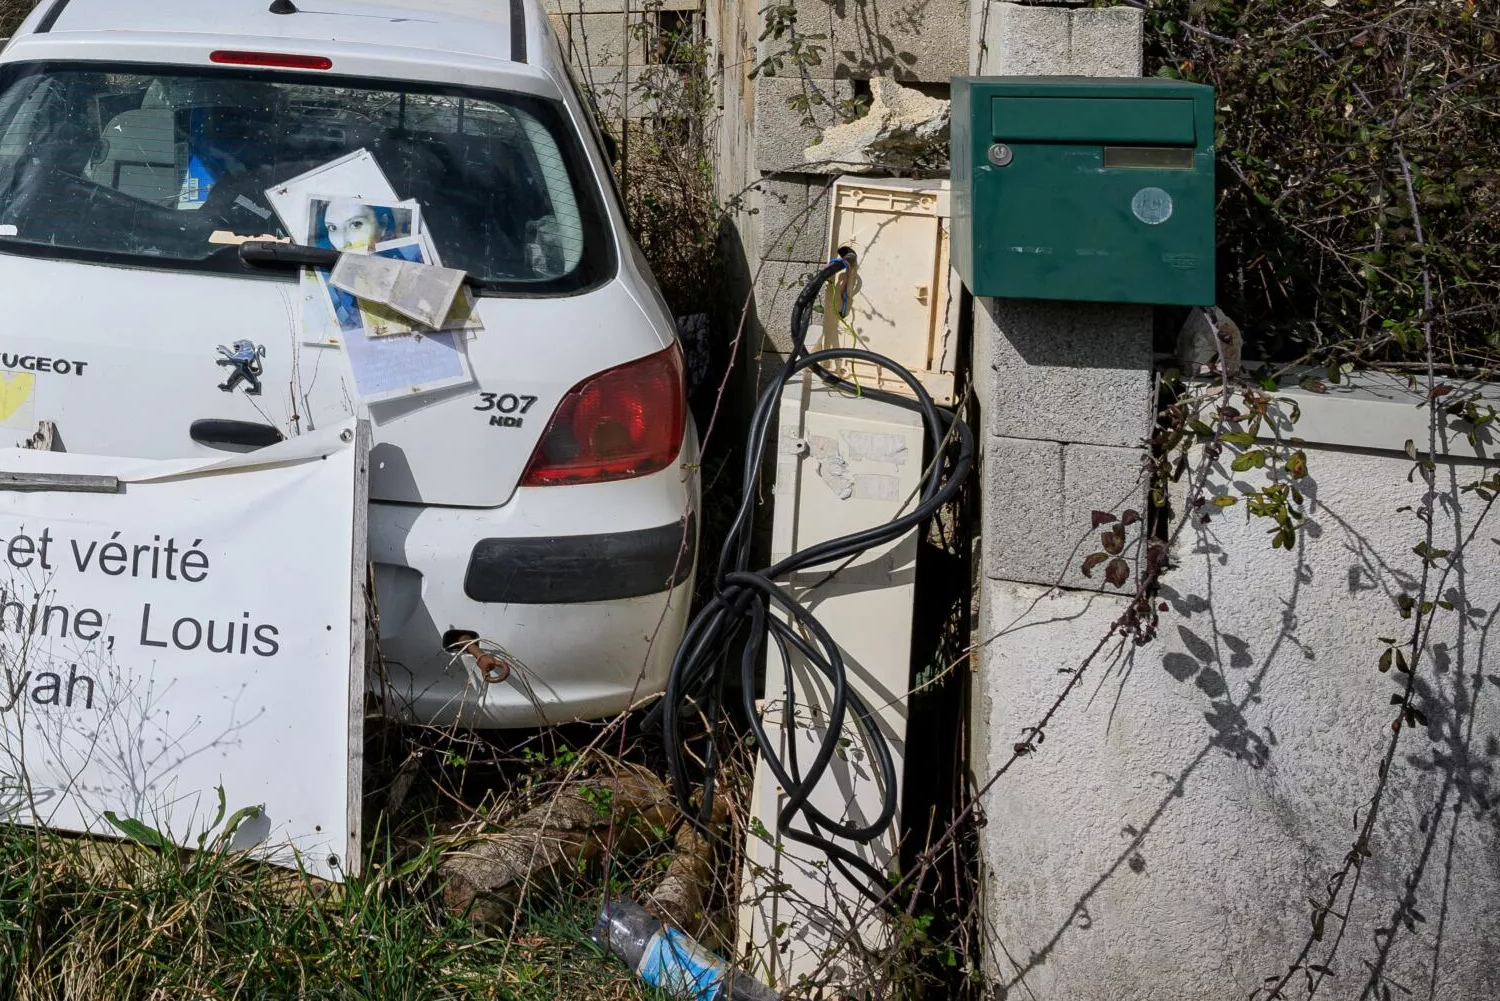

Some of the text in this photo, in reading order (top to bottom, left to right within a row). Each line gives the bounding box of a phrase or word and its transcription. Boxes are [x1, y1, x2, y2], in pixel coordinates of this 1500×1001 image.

[473, 392, 539, 414] 307
[7, 526, 54, 570] et
[70, 530, 210, 583] vérité
[140, 603, 280, 657] Louis
